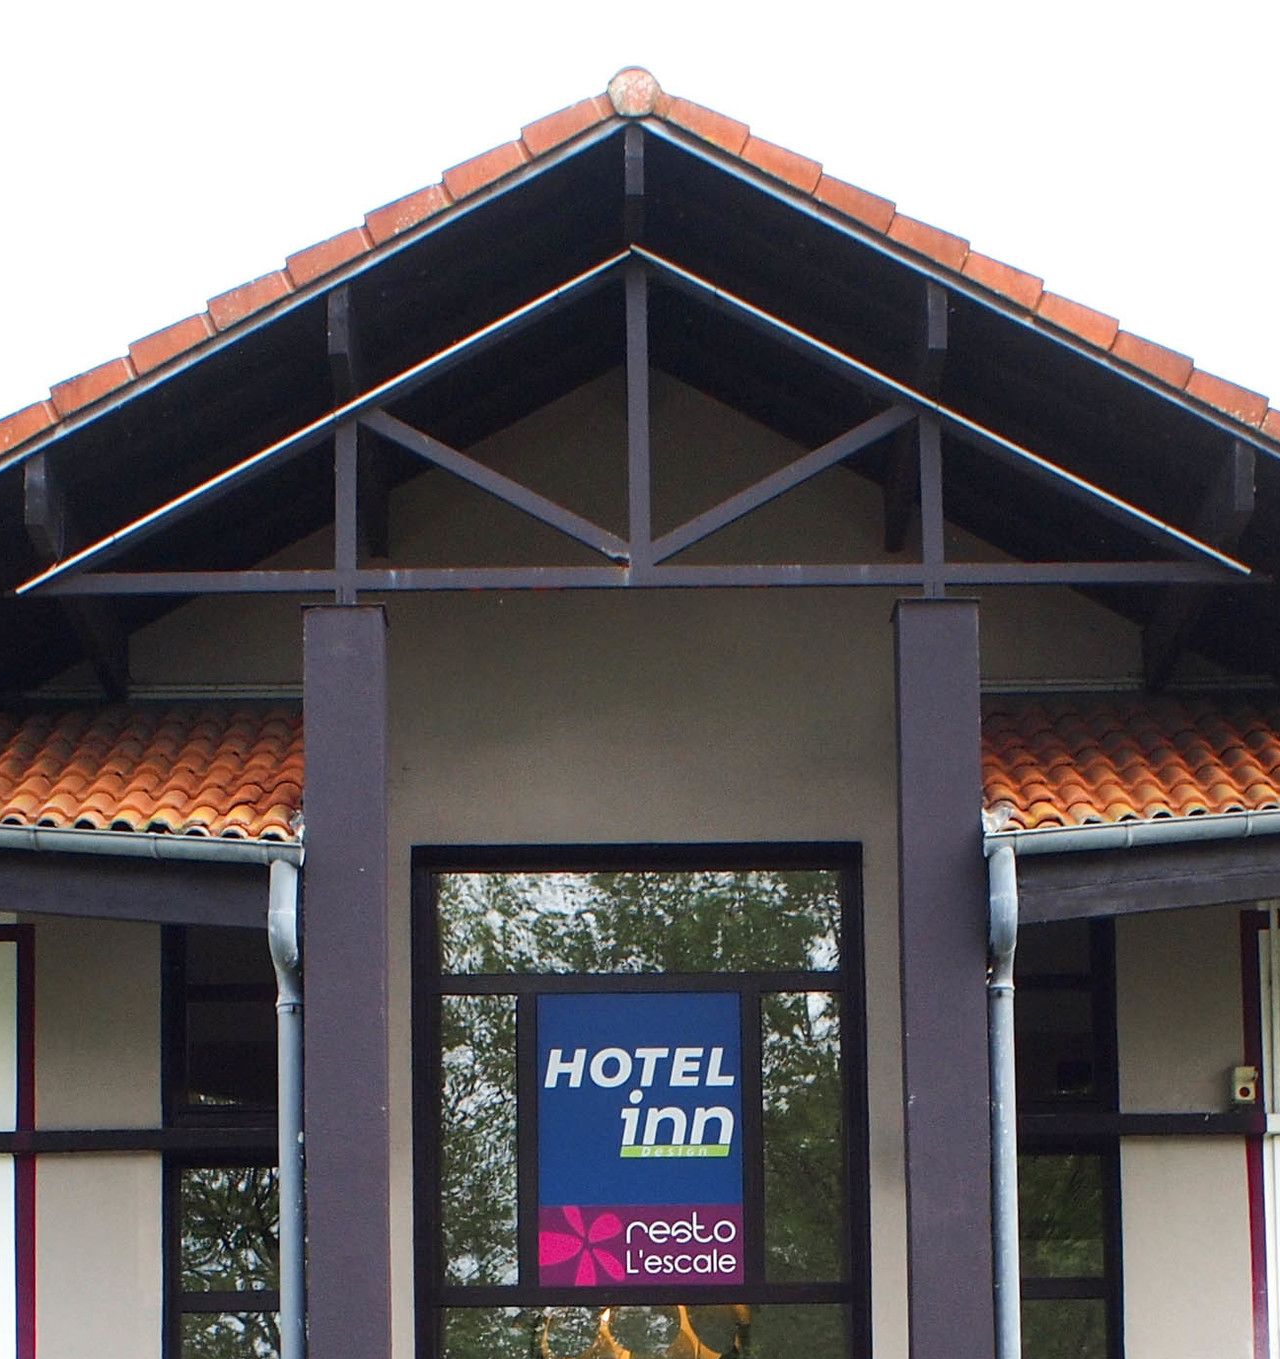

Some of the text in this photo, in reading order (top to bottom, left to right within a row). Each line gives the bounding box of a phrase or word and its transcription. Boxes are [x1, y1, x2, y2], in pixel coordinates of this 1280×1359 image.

[544, 1047, 735, 1088] HOTEL
[621, 1089, 734, 1145] inn
[626, 1211, 736, 1244] resto
[626, 1249, 737, 1274] L'escale
